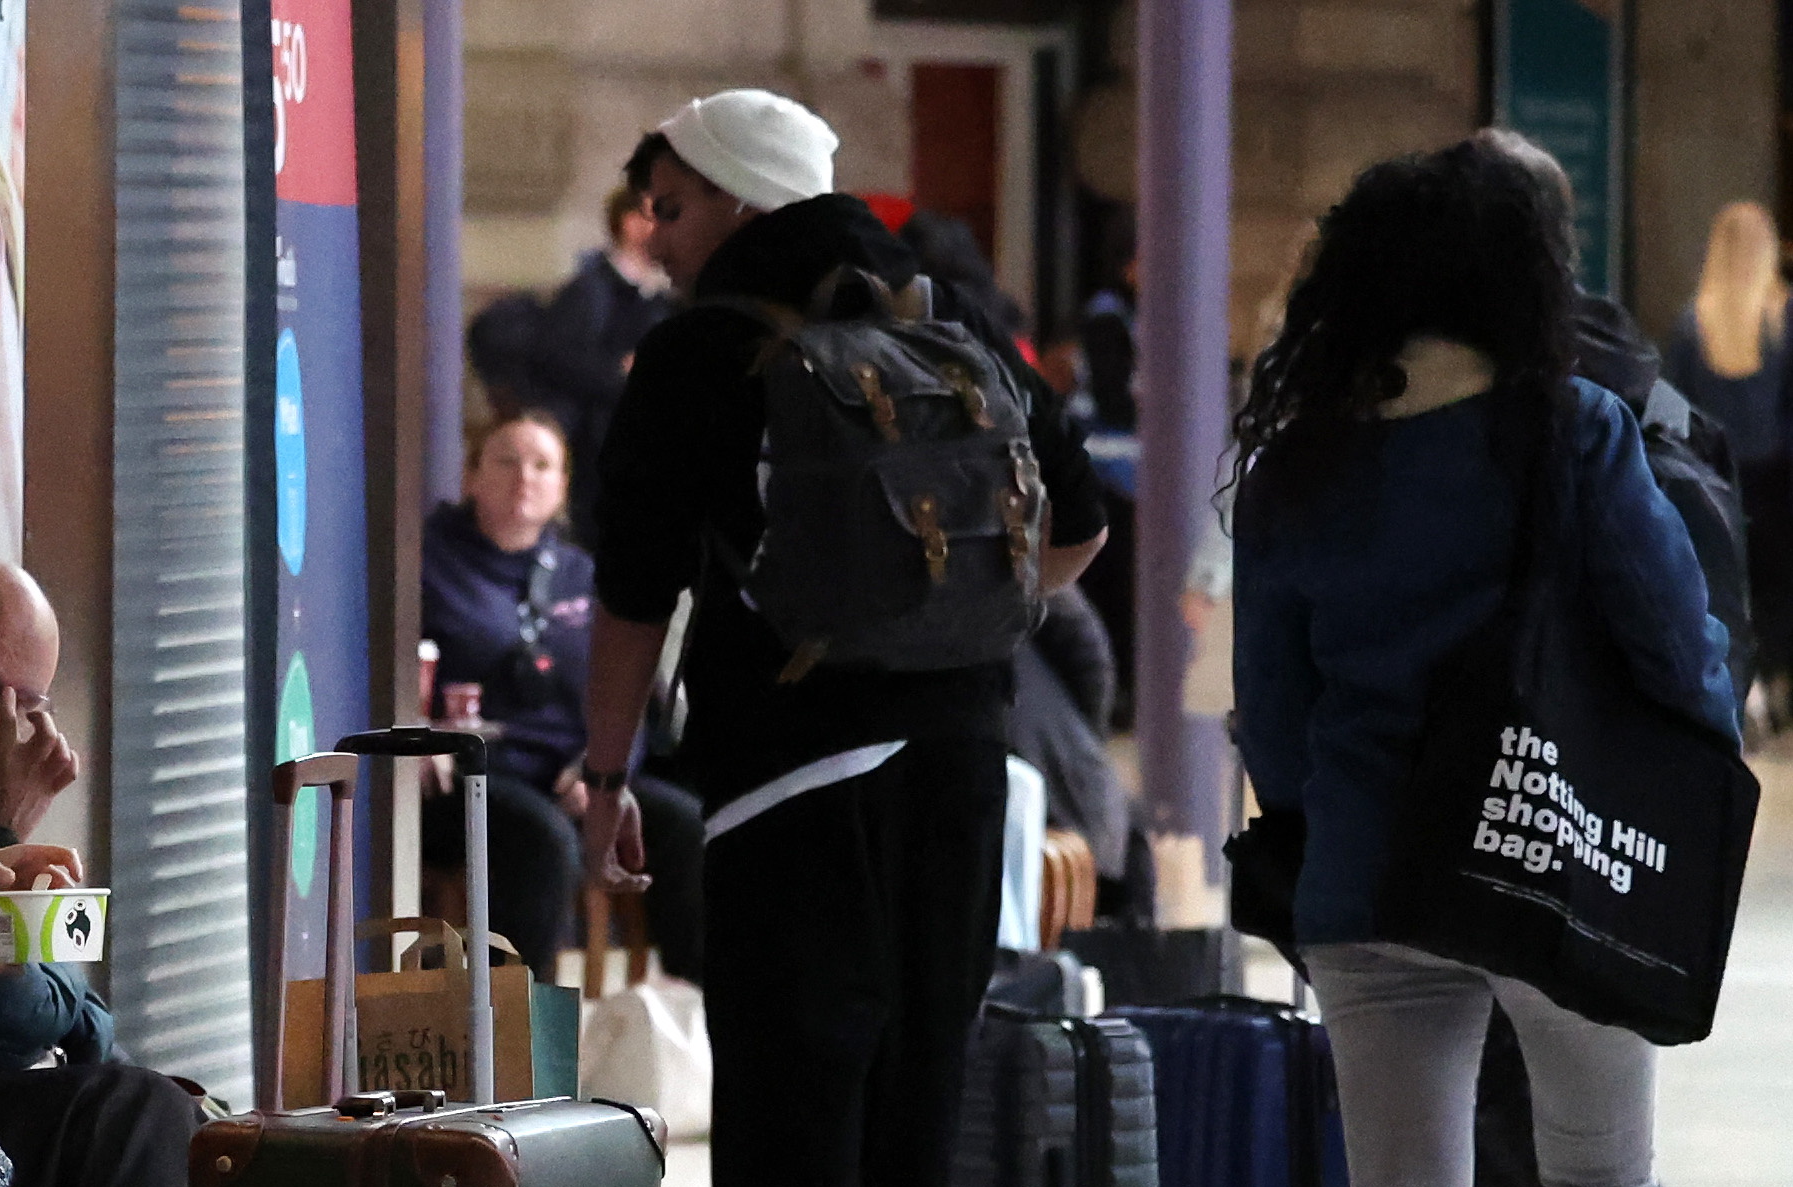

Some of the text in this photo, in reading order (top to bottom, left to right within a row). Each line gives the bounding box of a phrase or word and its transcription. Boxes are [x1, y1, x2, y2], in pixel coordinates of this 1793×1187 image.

[1500, 726, 1558, 766] the
[1473, 820, 1563, 874] bag.
[1481, 793, 1633, 894] shopping
[1489, 758, 1667, 874] Notting Hill
